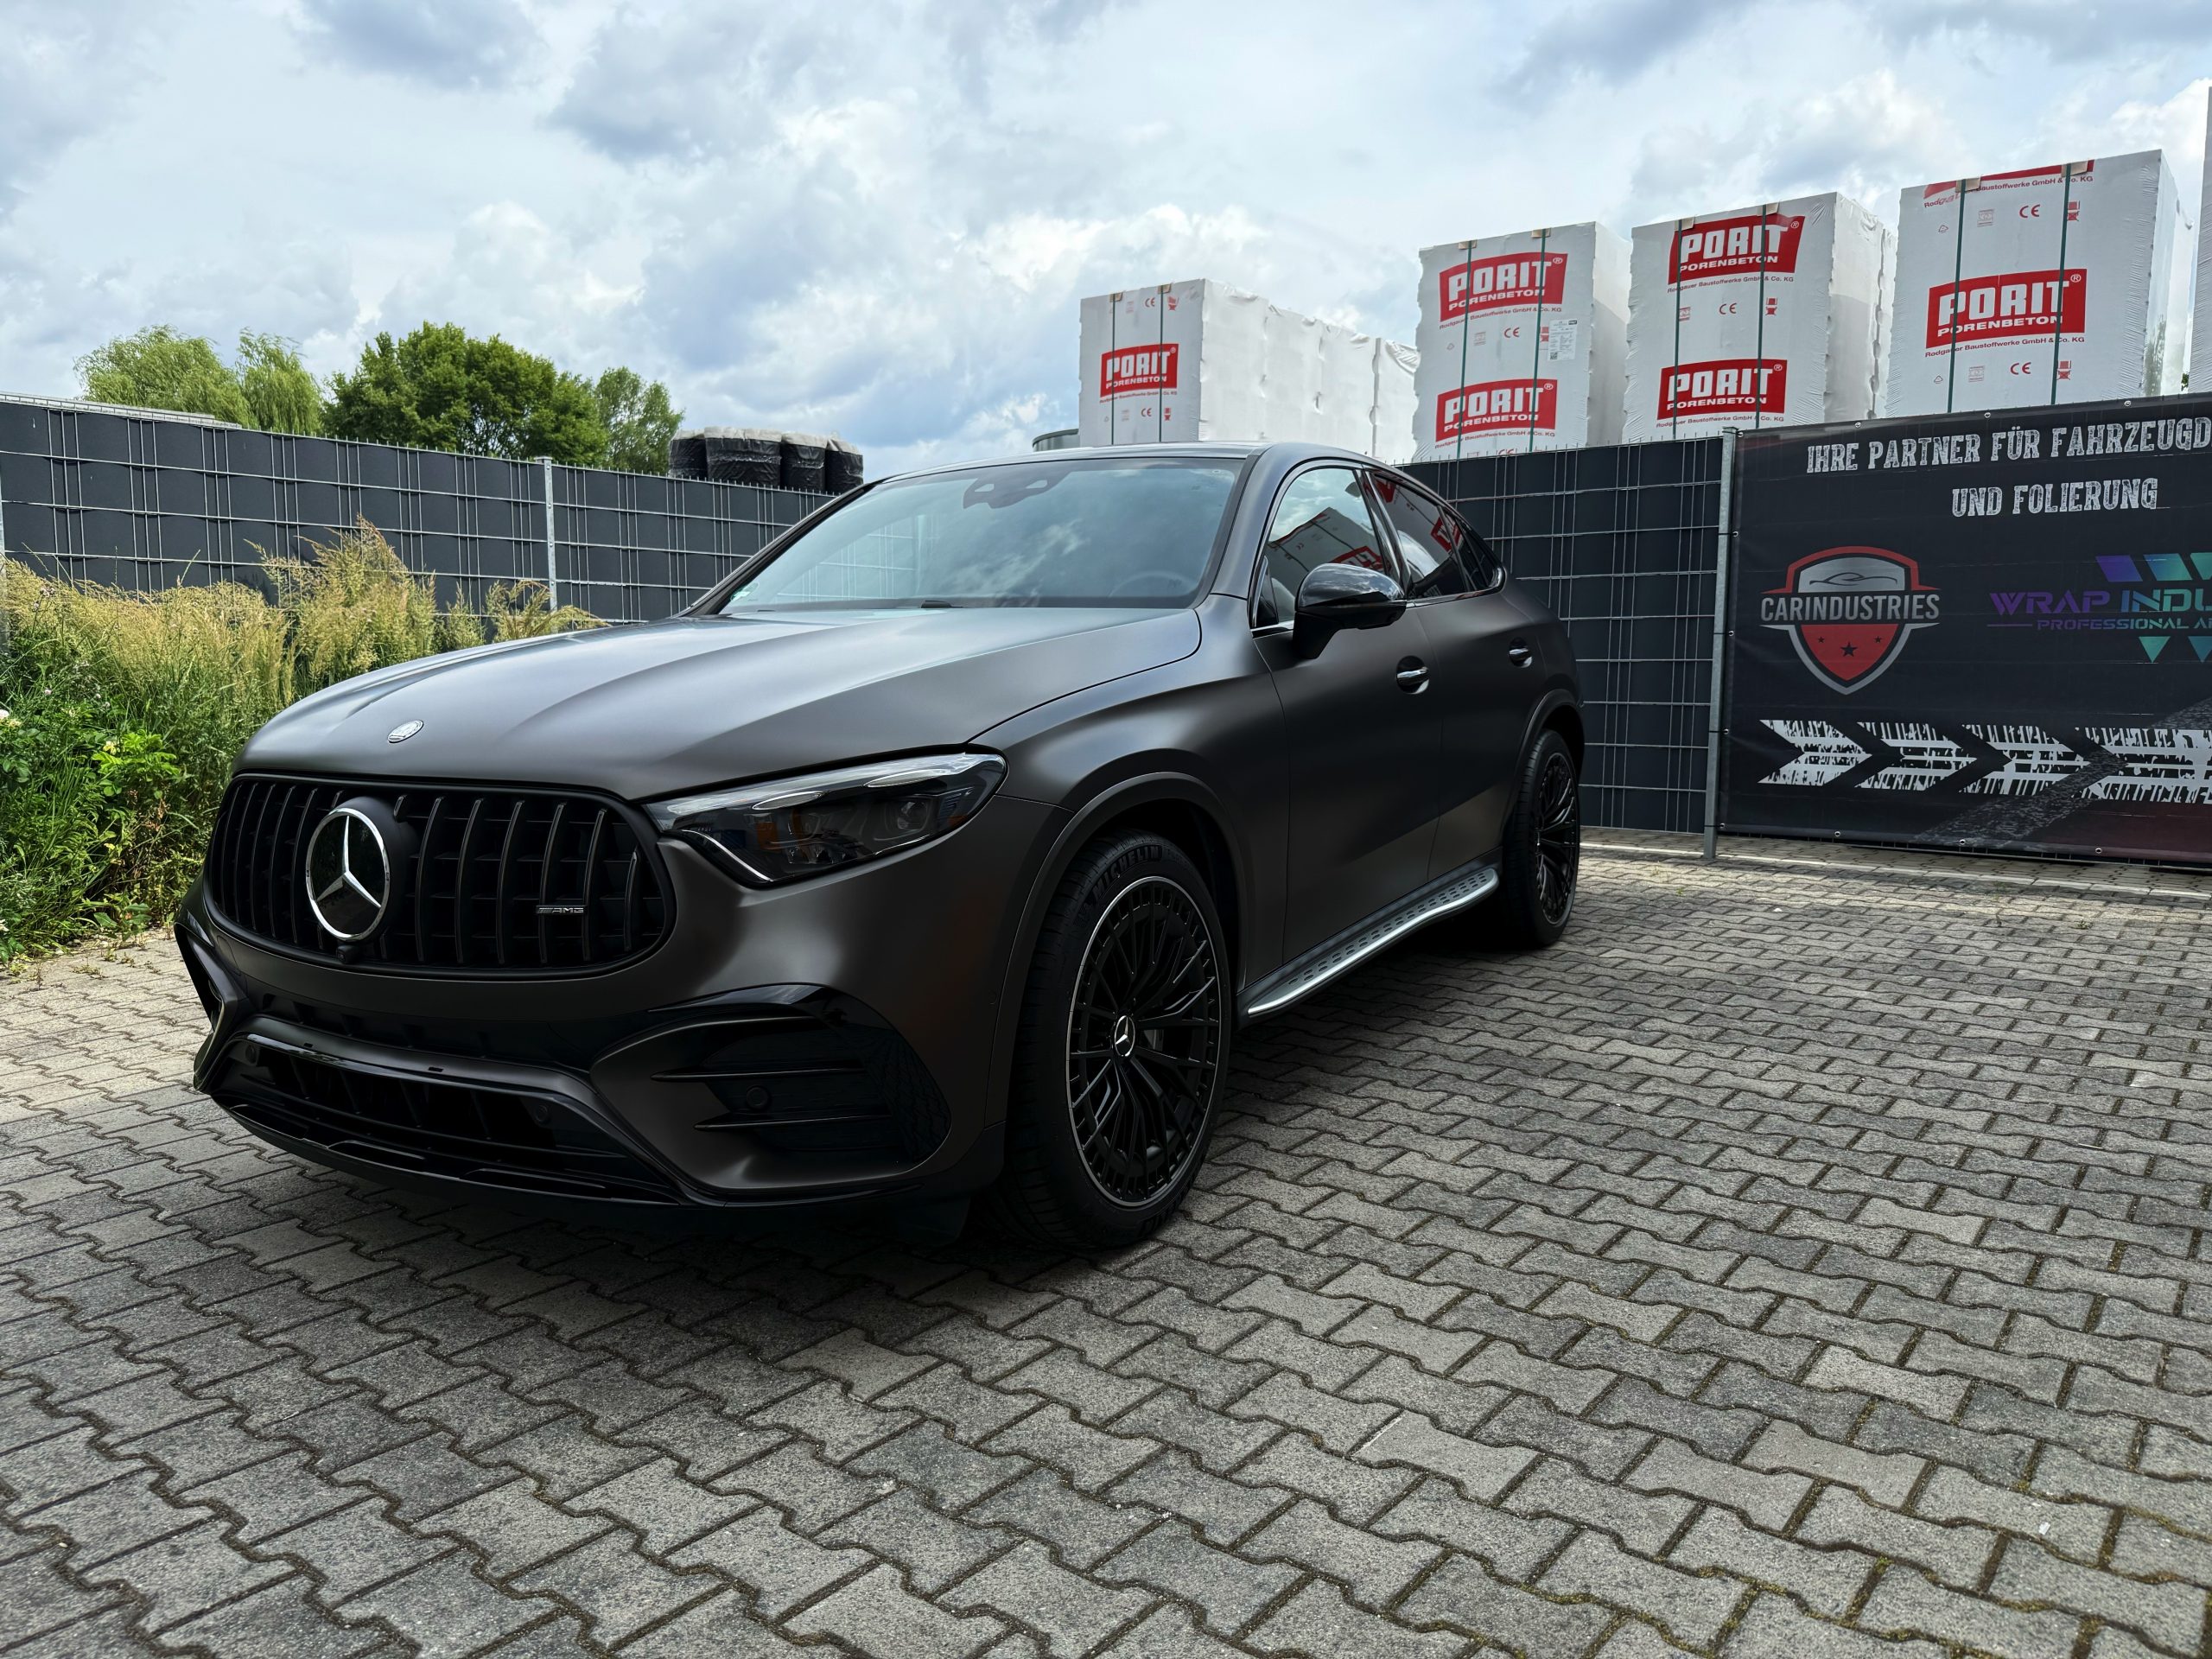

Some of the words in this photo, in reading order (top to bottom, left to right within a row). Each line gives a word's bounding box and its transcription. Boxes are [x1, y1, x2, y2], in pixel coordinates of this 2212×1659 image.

[1680, 256, 1778, 273] PORENBETON
[1448, 289, 1545, 311] PORENBETON
[1937, 315, 2063, 337] PORENBETON
[1924, 346, 1963, 358] Rodgaer
[1666, 397, 1767, 411] PORENBETON
[1444, 414, 1539, 433] PORENBETON
[1806, 442, 1859, 474] IHRE
[1867, 434, 1981, 469] PARTNER
[1990, 426, 2040, 461] FÜR
[1951, 486, 2003, 518] UND
[2012, 477, 2158, 515] FOLIERUNG
[1760, 594, 1940, 623] CARINDUSTRIES
[1989, 588, 2111, 616] WRAP
[2037, 617, 2190, 631] PROFESSIONAL
